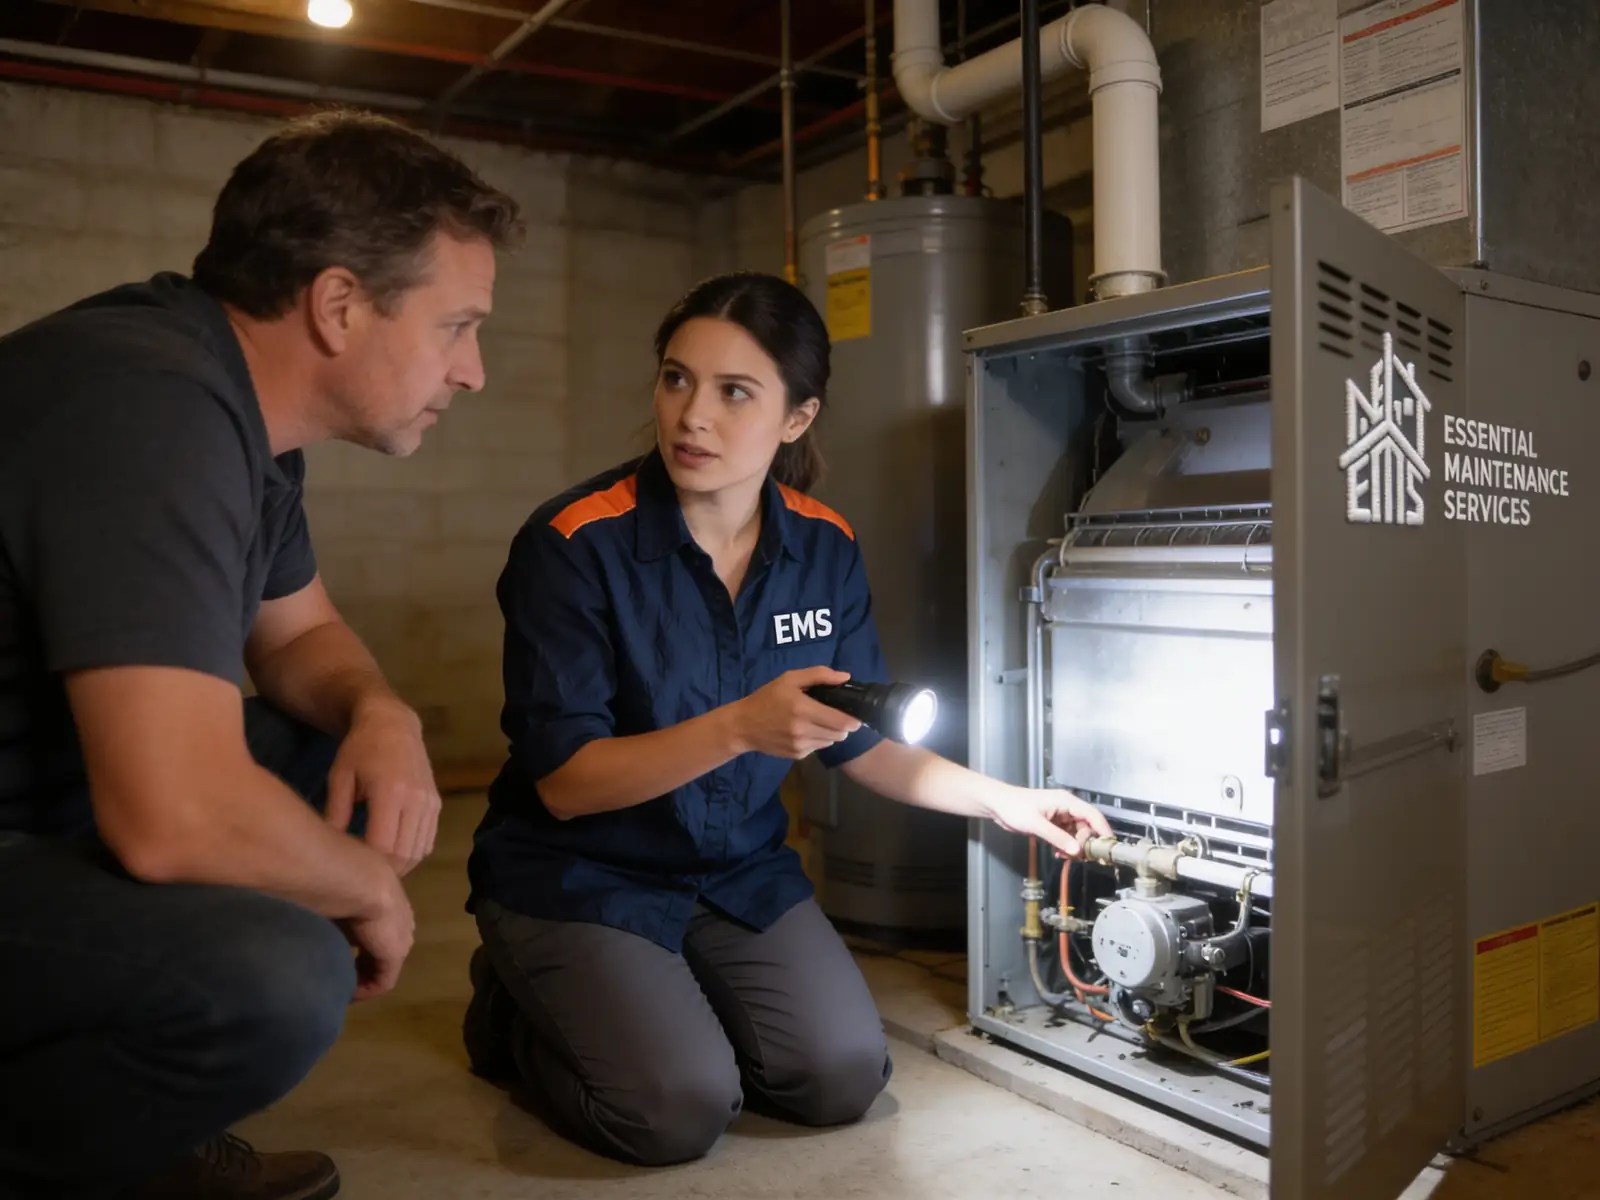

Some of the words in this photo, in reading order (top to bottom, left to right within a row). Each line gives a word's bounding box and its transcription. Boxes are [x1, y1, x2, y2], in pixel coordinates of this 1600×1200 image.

[1443, 414, 1538, 459] ESSENTIAL
[1443, 451, 1569, 497] MAINTENANCE
[1443, 489, 1531, 526] SERVICES
[773, 608, 833, 645] EMS
